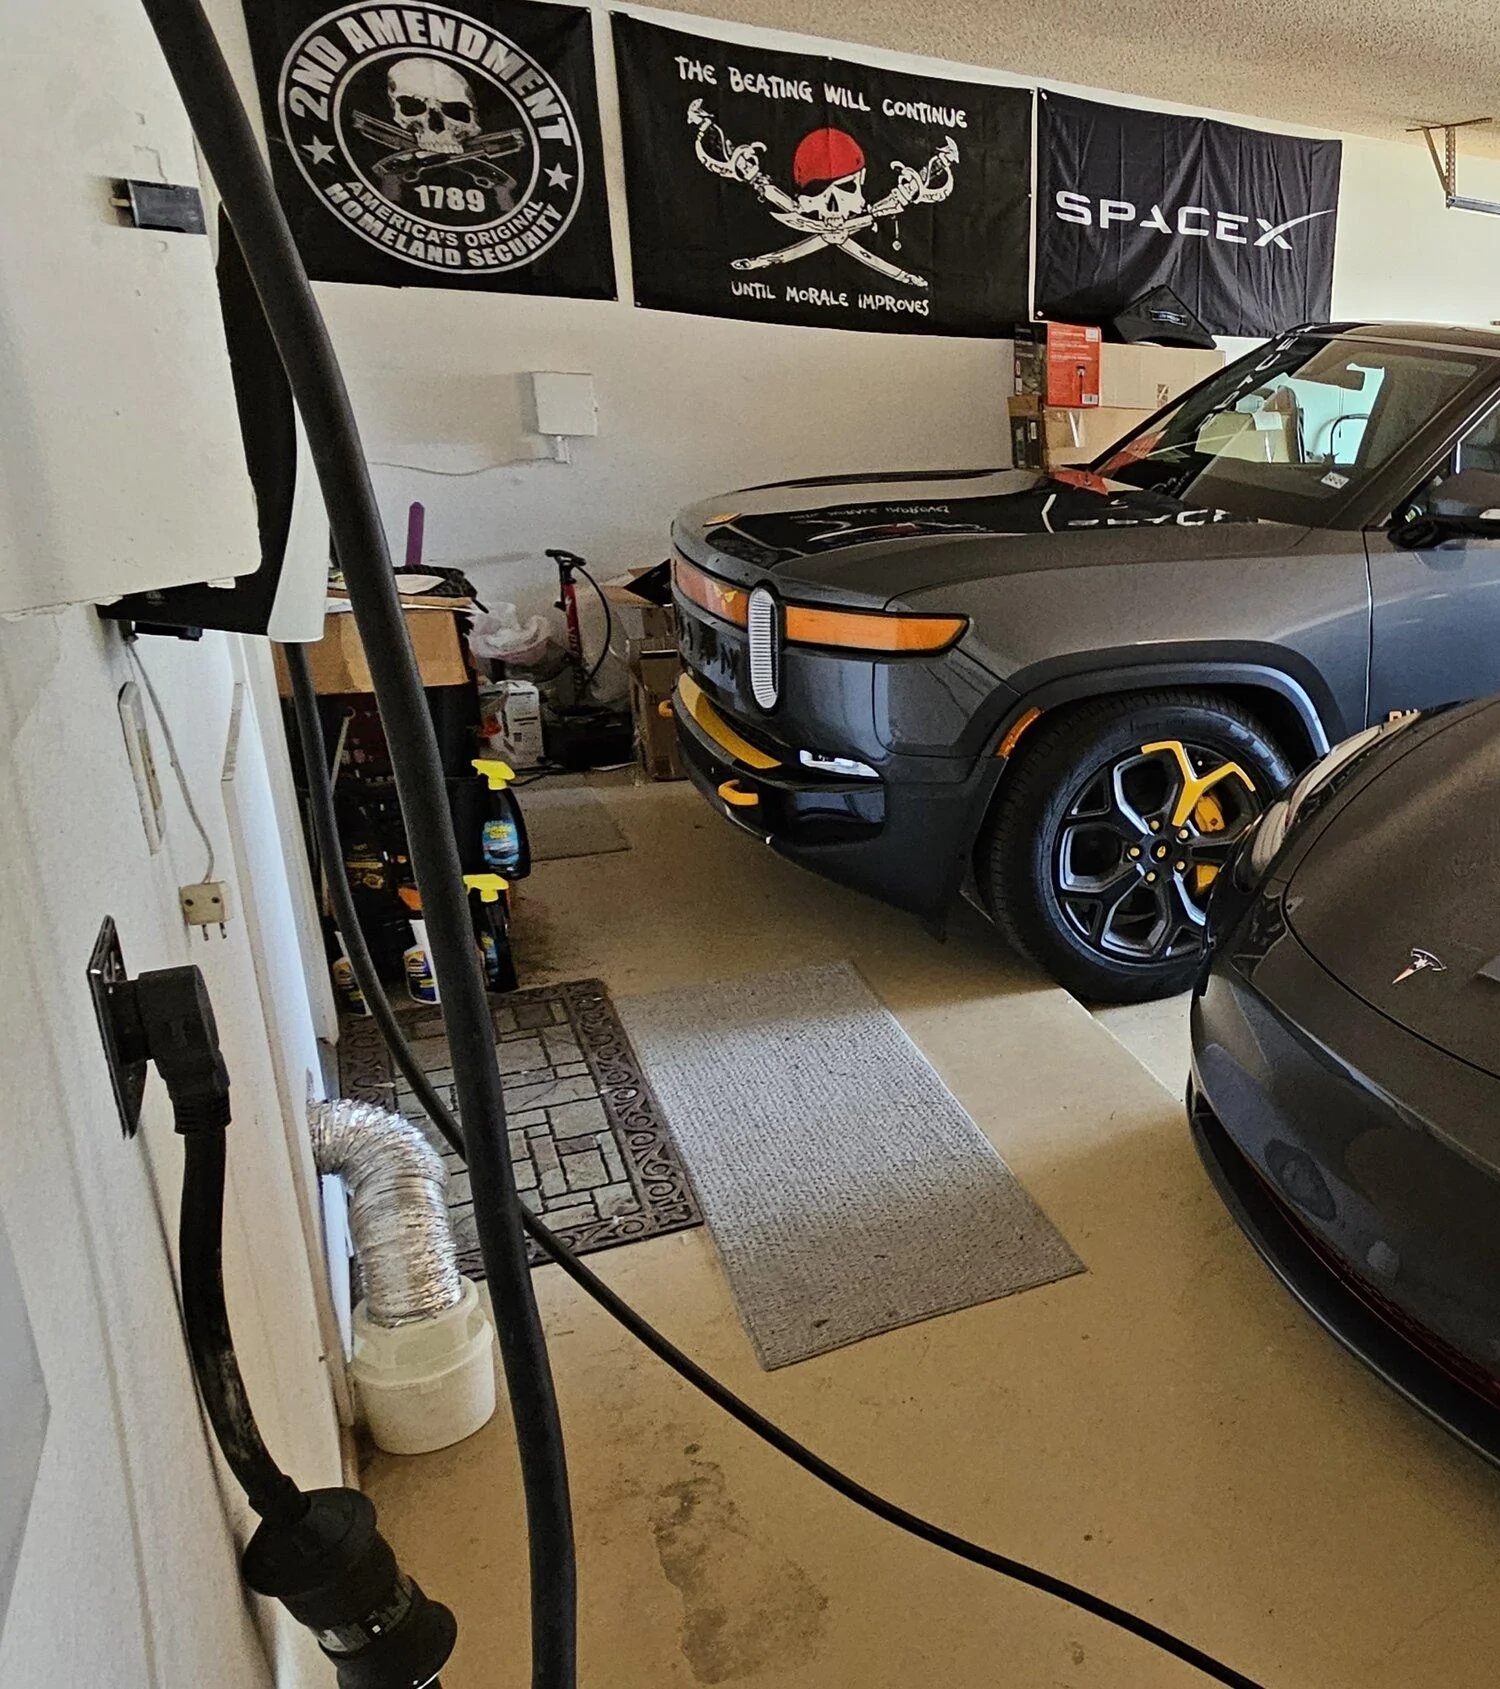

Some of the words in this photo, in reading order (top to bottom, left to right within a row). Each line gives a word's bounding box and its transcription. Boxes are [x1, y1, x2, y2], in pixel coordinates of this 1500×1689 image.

[289, 35, 347, 122] 2ND
[336, 9, 572, 146] AMENDMENT
[674, 55, 717, 85] THE
[728, 66, 814, 103] BEATING
[823, 82, 870, 111] WILL
[882, 98, 967, 128] CONTINUE
[324, 183, 462, 266] HOMELAND
[466, 203, 562, 267] SECURITY
[346, 181, 459, 247] AMERICA'S
[464, 200, 544, 247] ORIGINAL
[414, 184, 486, 213] 1789
[1056, 190, 1336, 250] SPACEX
[731, 280, 776, 300] UNTIL
[786, 286, 849, 307] MORALE
[858, 293, 930, 317] IMPROVES
